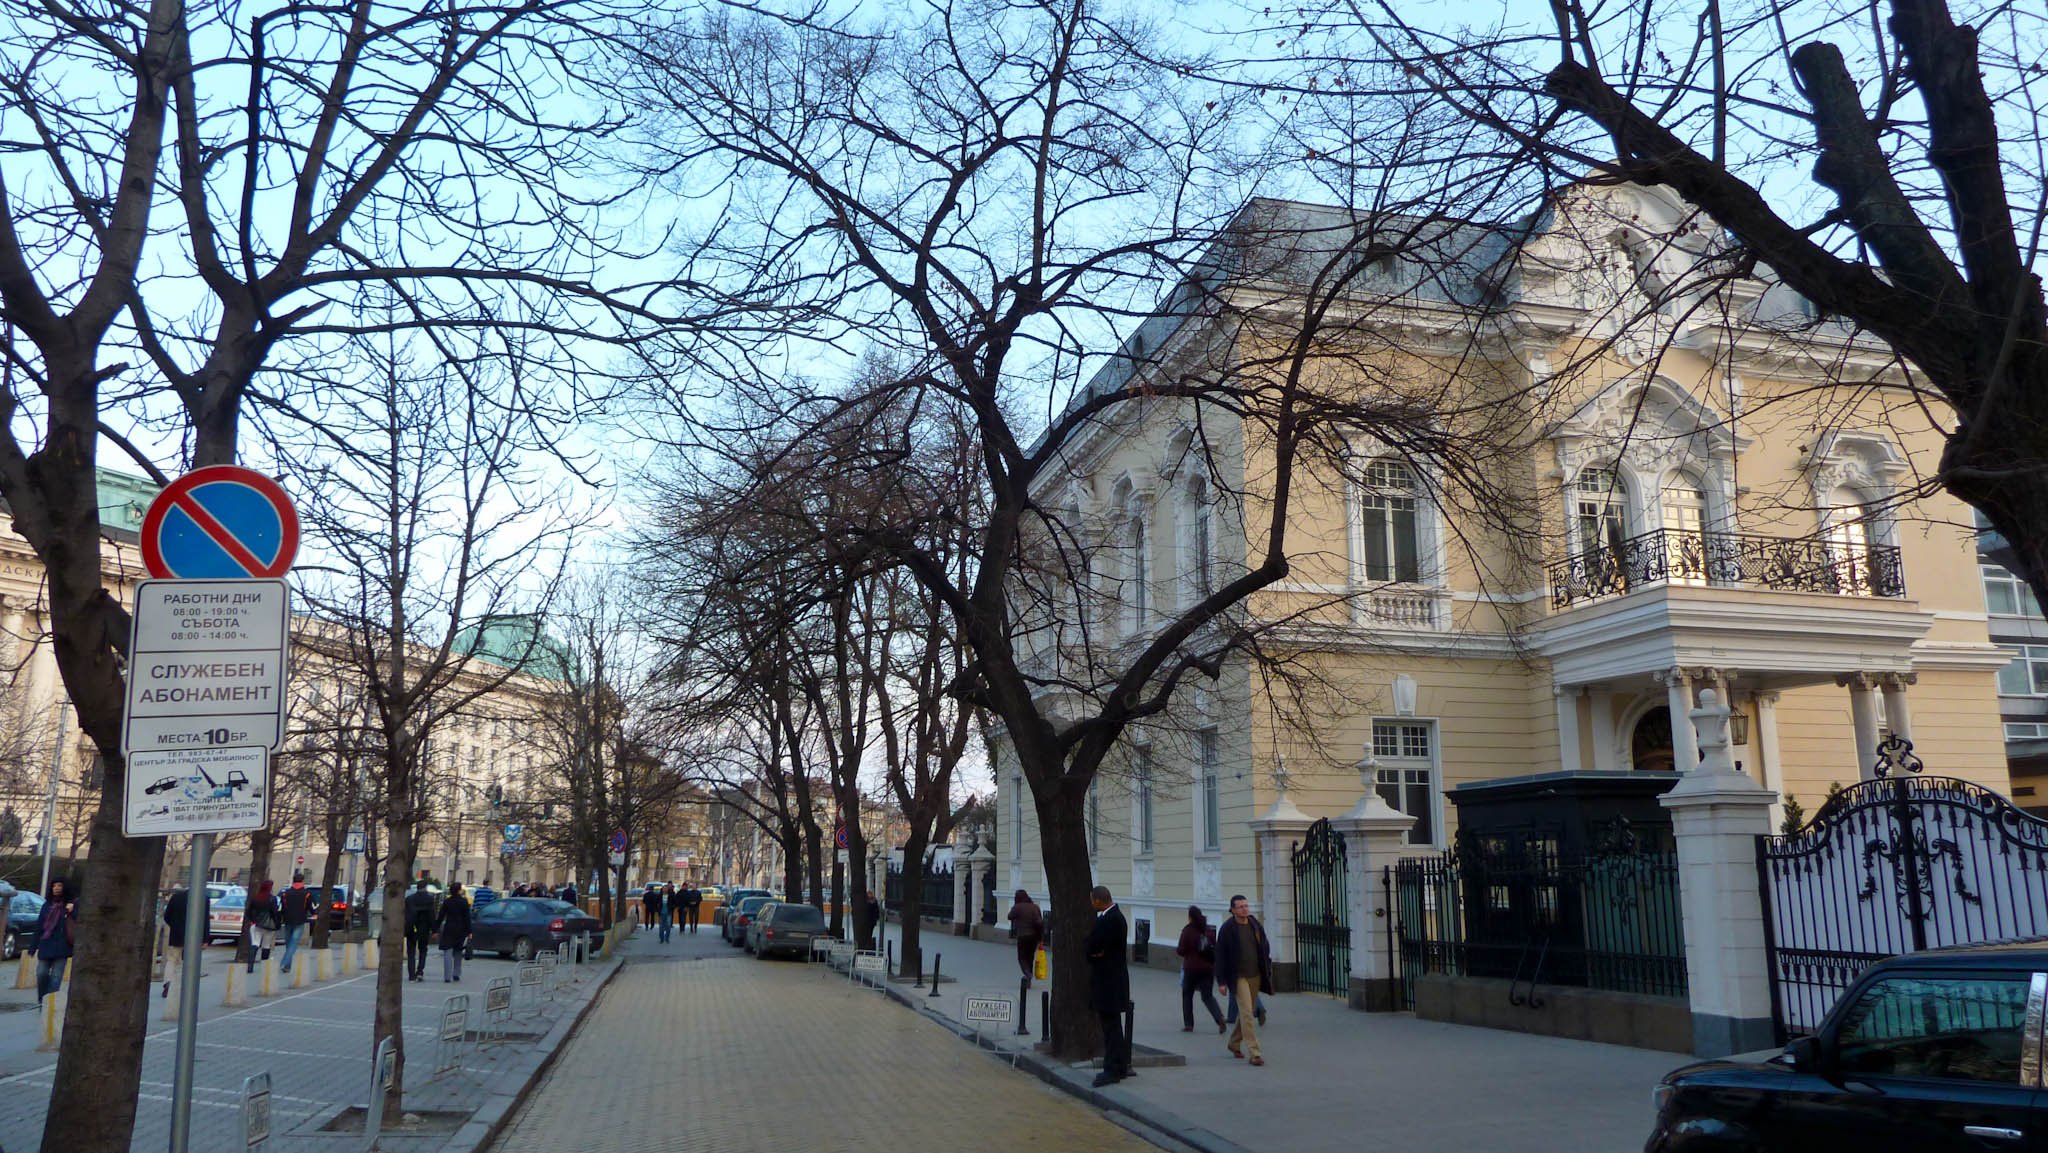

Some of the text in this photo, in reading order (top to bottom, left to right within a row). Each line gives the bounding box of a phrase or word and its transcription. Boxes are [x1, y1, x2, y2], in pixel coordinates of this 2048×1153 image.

[163, 592, 262, 605] РАБОТНИ ДНИ
[172, 608, 201, 617] 08:00
[211, 607, 239, 616] 19:00
[181, 617, 241, 629] СЪБОТА
[171, 631, 200, 641] 08:00
[210, 631, 237, 640] 14:00
[151, 662, 265, 679] СЛУЖЕБЕН
[139, 685, 272, 703] АБОНАМЕНТ
[203, 728, 230, 745] 10
[230, 731, 249, 742] БР.
[134, 758, 166, 768] ЦЕНТЪР
[178, 756, 211, 764] ГРАДСКА
[212, 753, 260, 762] МОБИЛНОСТ
